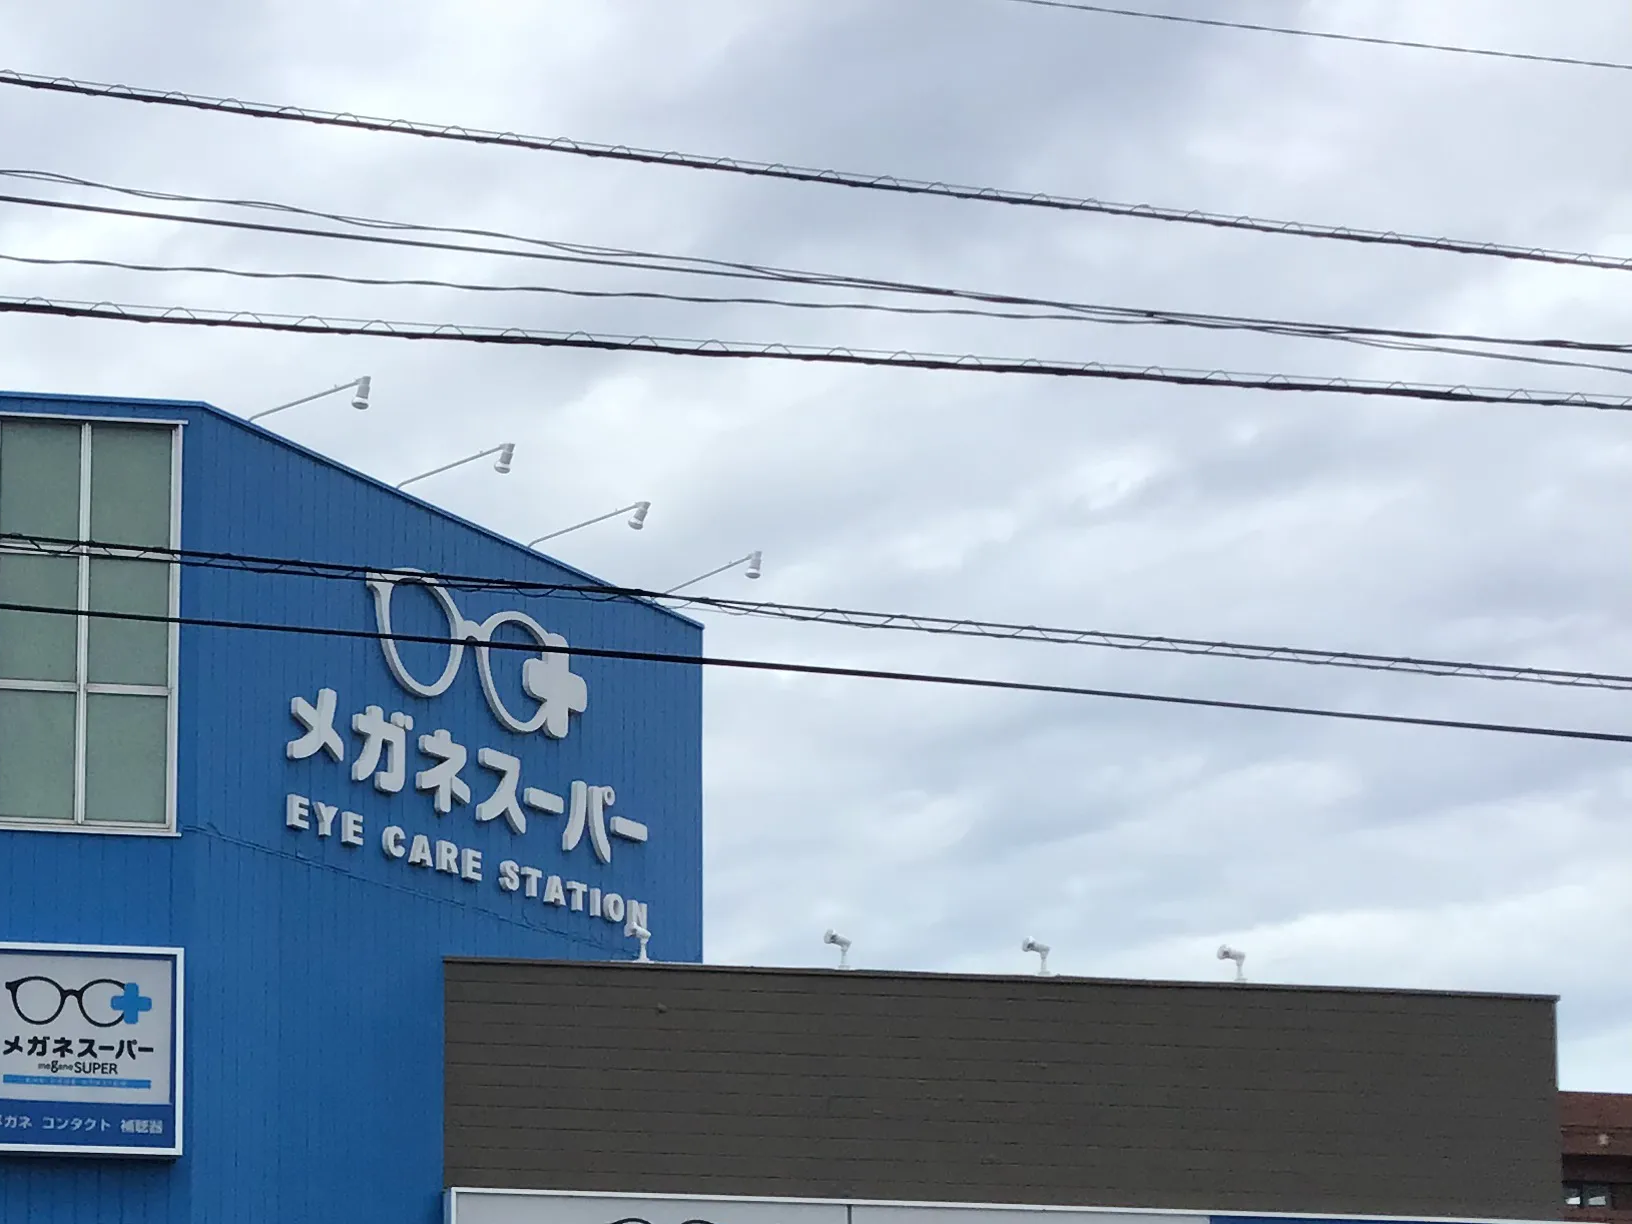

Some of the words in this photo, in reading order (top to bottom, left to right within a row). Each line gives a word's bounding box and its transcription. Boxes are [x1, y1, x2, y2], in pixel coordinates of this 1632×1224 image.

[286, 687, 648, 864] メガネスーパー
[286, 793, 364, 846] EYE
[382, 825, 483, 882] CARE
[499, 860, 648, 927] STATION
[3, 1036, 154, 1060] メガネスーパー
[42, 1116, 111, 1132] コンタクト
